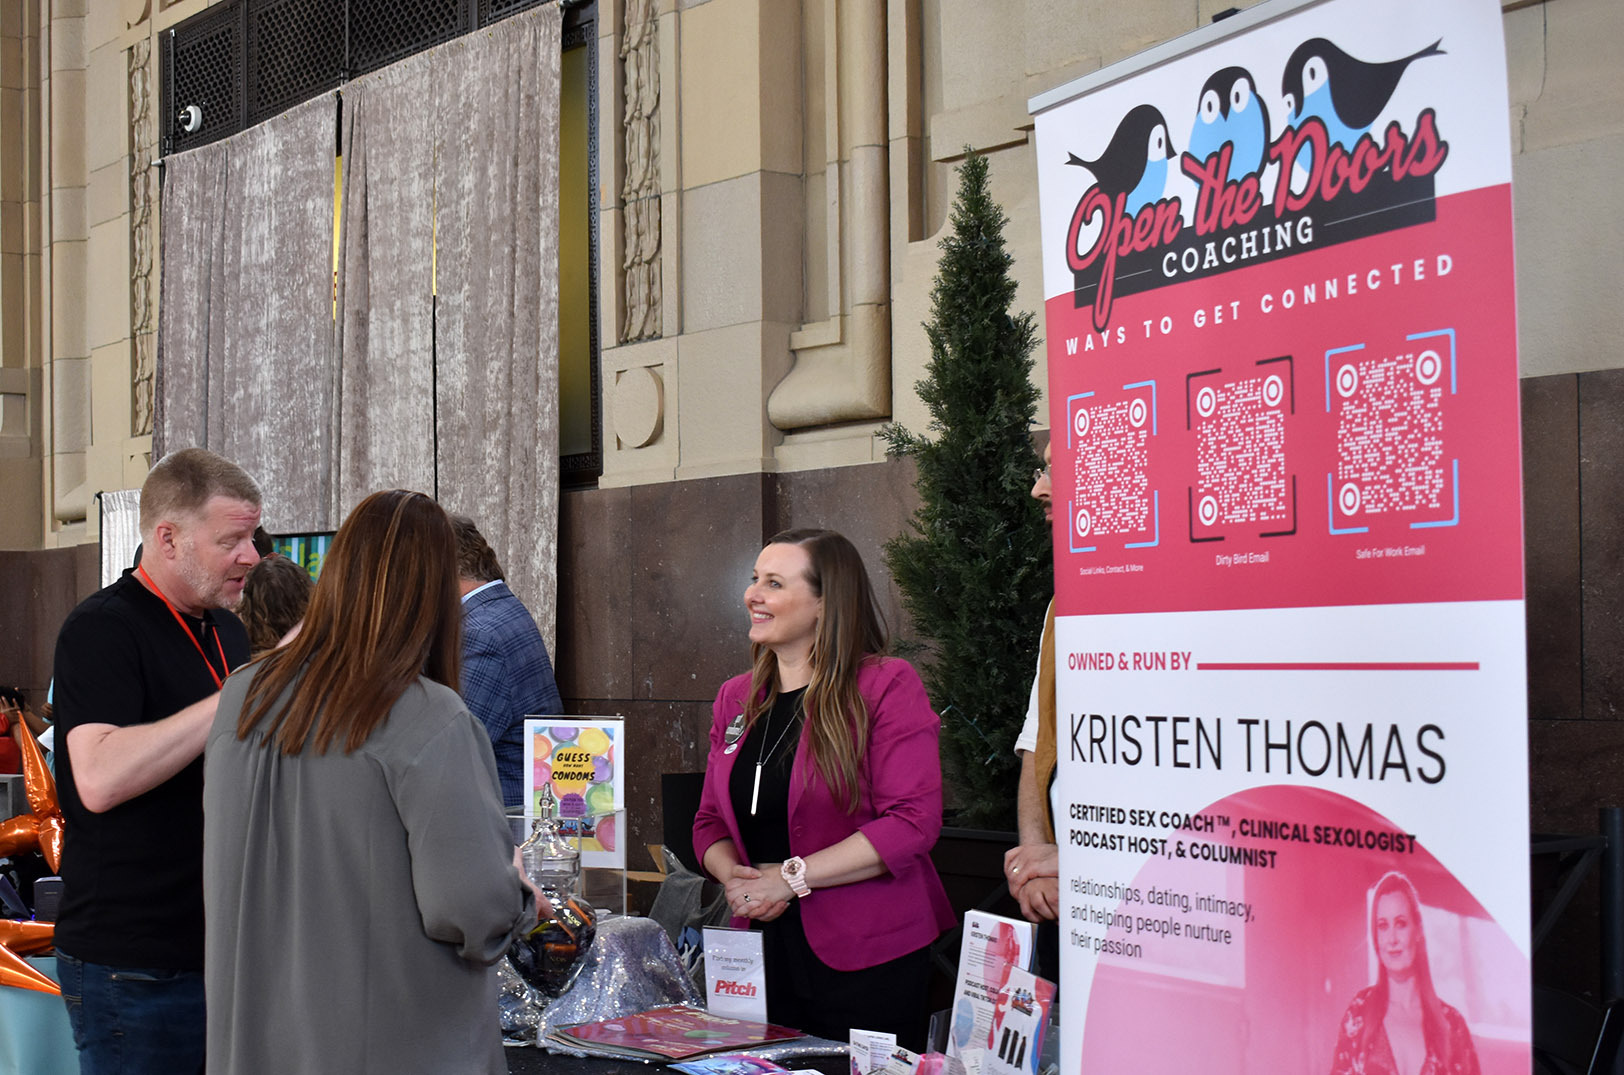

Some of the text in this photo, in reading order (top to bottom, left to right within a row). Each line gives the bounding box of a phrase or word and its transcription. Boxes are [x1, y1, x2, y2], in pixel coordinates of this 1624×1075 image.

[1067, 108, 1448, 332] Open the Doors
[1163, 216, 1314, 278] COACHING
[1066, 254, 1454, 356] WAYS TO GET CONNECTED
[1080, 567, 1093, 576] Social
[1106, 565, 1125, 574] Contact,
[1130, 564, 1144, 573] More
[1216, 551, 1269, 567] Dirty Bird Email
[1356, 545, 1426, 560] Safe For Work Email
[1068, 651, 1192, 671] OWNED & RUN BY
[556, 752, 591, 763] GUESS
[1070, 713, 1447, 785] KRISTEN THOMAS
[551, 771, 596, 781] CONDOMS
[1070, 803, 1126, 826] CERTIFIED
[1129, 809, 1156, 828] SEX
[1239, 818, 1310, 844] CLINICAL
[1314, 825, 1416, 855] SEXOLOGIST
[1070, 829, 1277, 869] PODCAST HOST, & COLUMNIST
[1070, 876, 1255, 922] relationships, dating, intimacy,
[1070, 904, 1232, 945] and helping people nurture
[1070, 928, 1142, 959] their passion
[714, 980, 757, 996] Pitch
